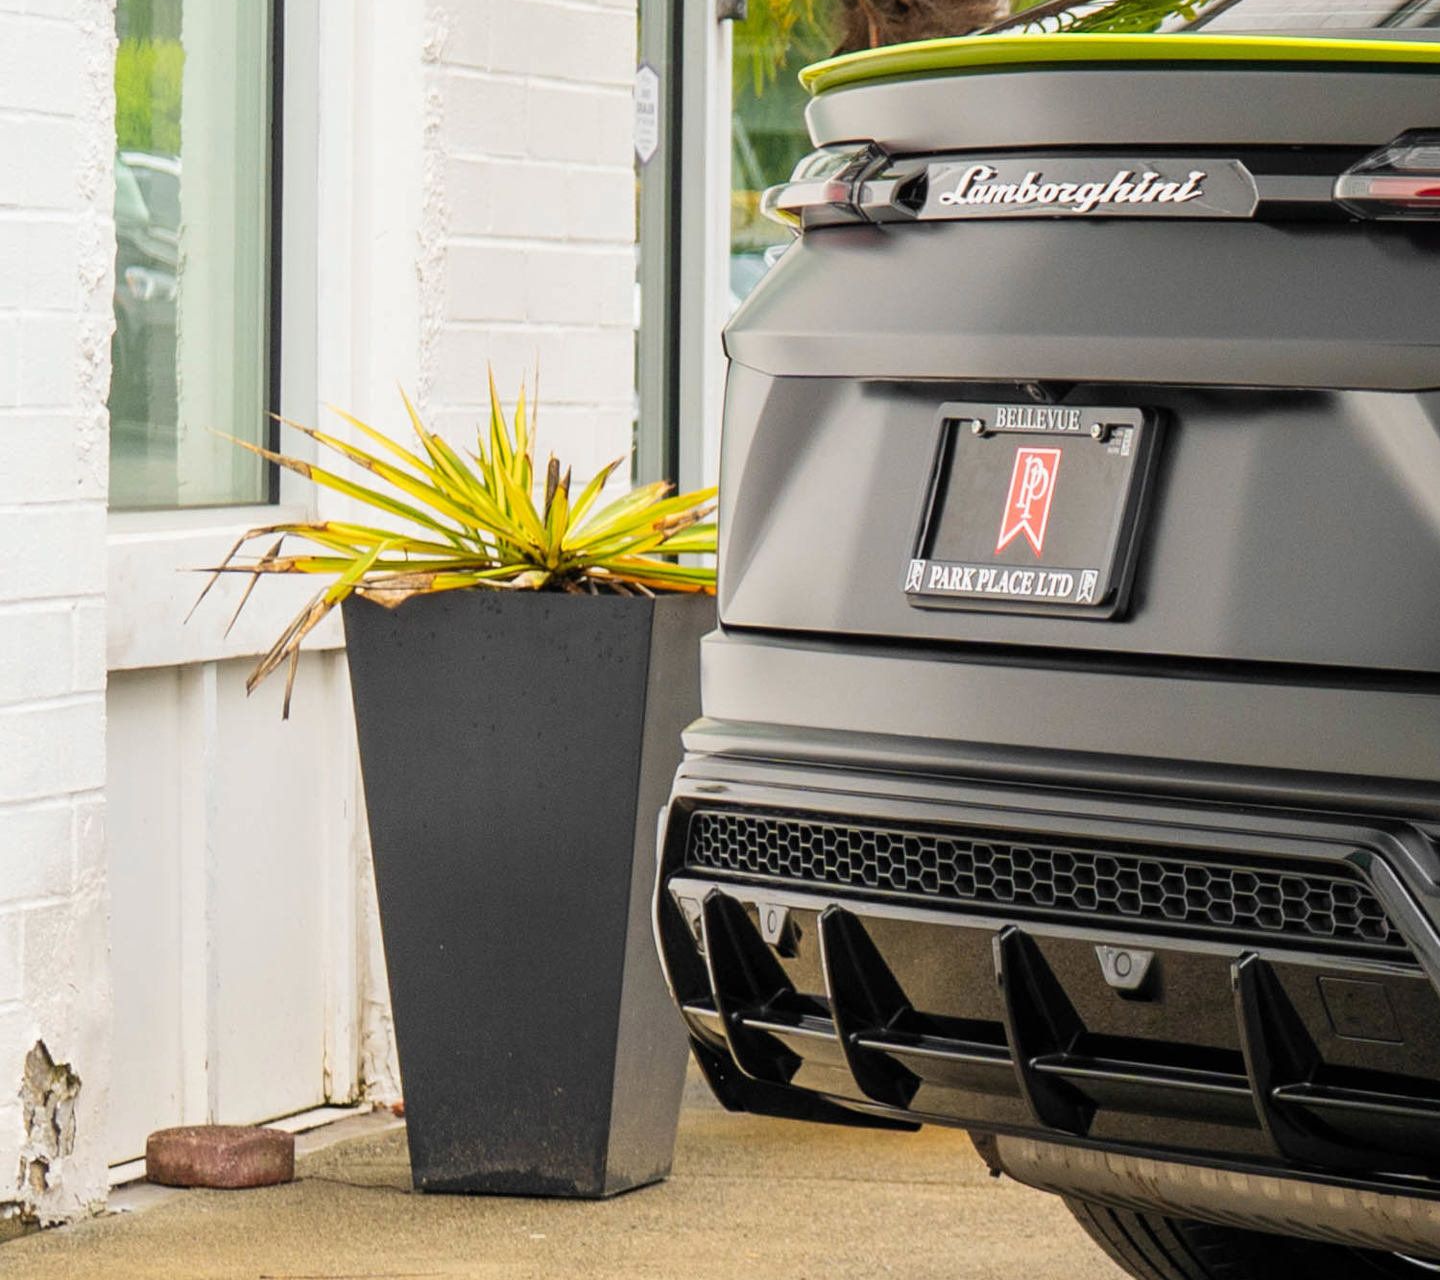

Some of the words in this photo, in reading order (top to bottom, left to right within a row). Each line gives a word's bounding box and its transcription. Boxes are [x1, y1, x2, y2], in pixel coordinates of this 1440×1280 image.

[939, 165, 1207, 212] Lamborghini
[995, 407, 1080, 430] BELLEVUE
[928, 566, 974, 591] PARK
[975, 569, 1034, 595] PLACE
[1035, 572, 1073, 597] LTD
